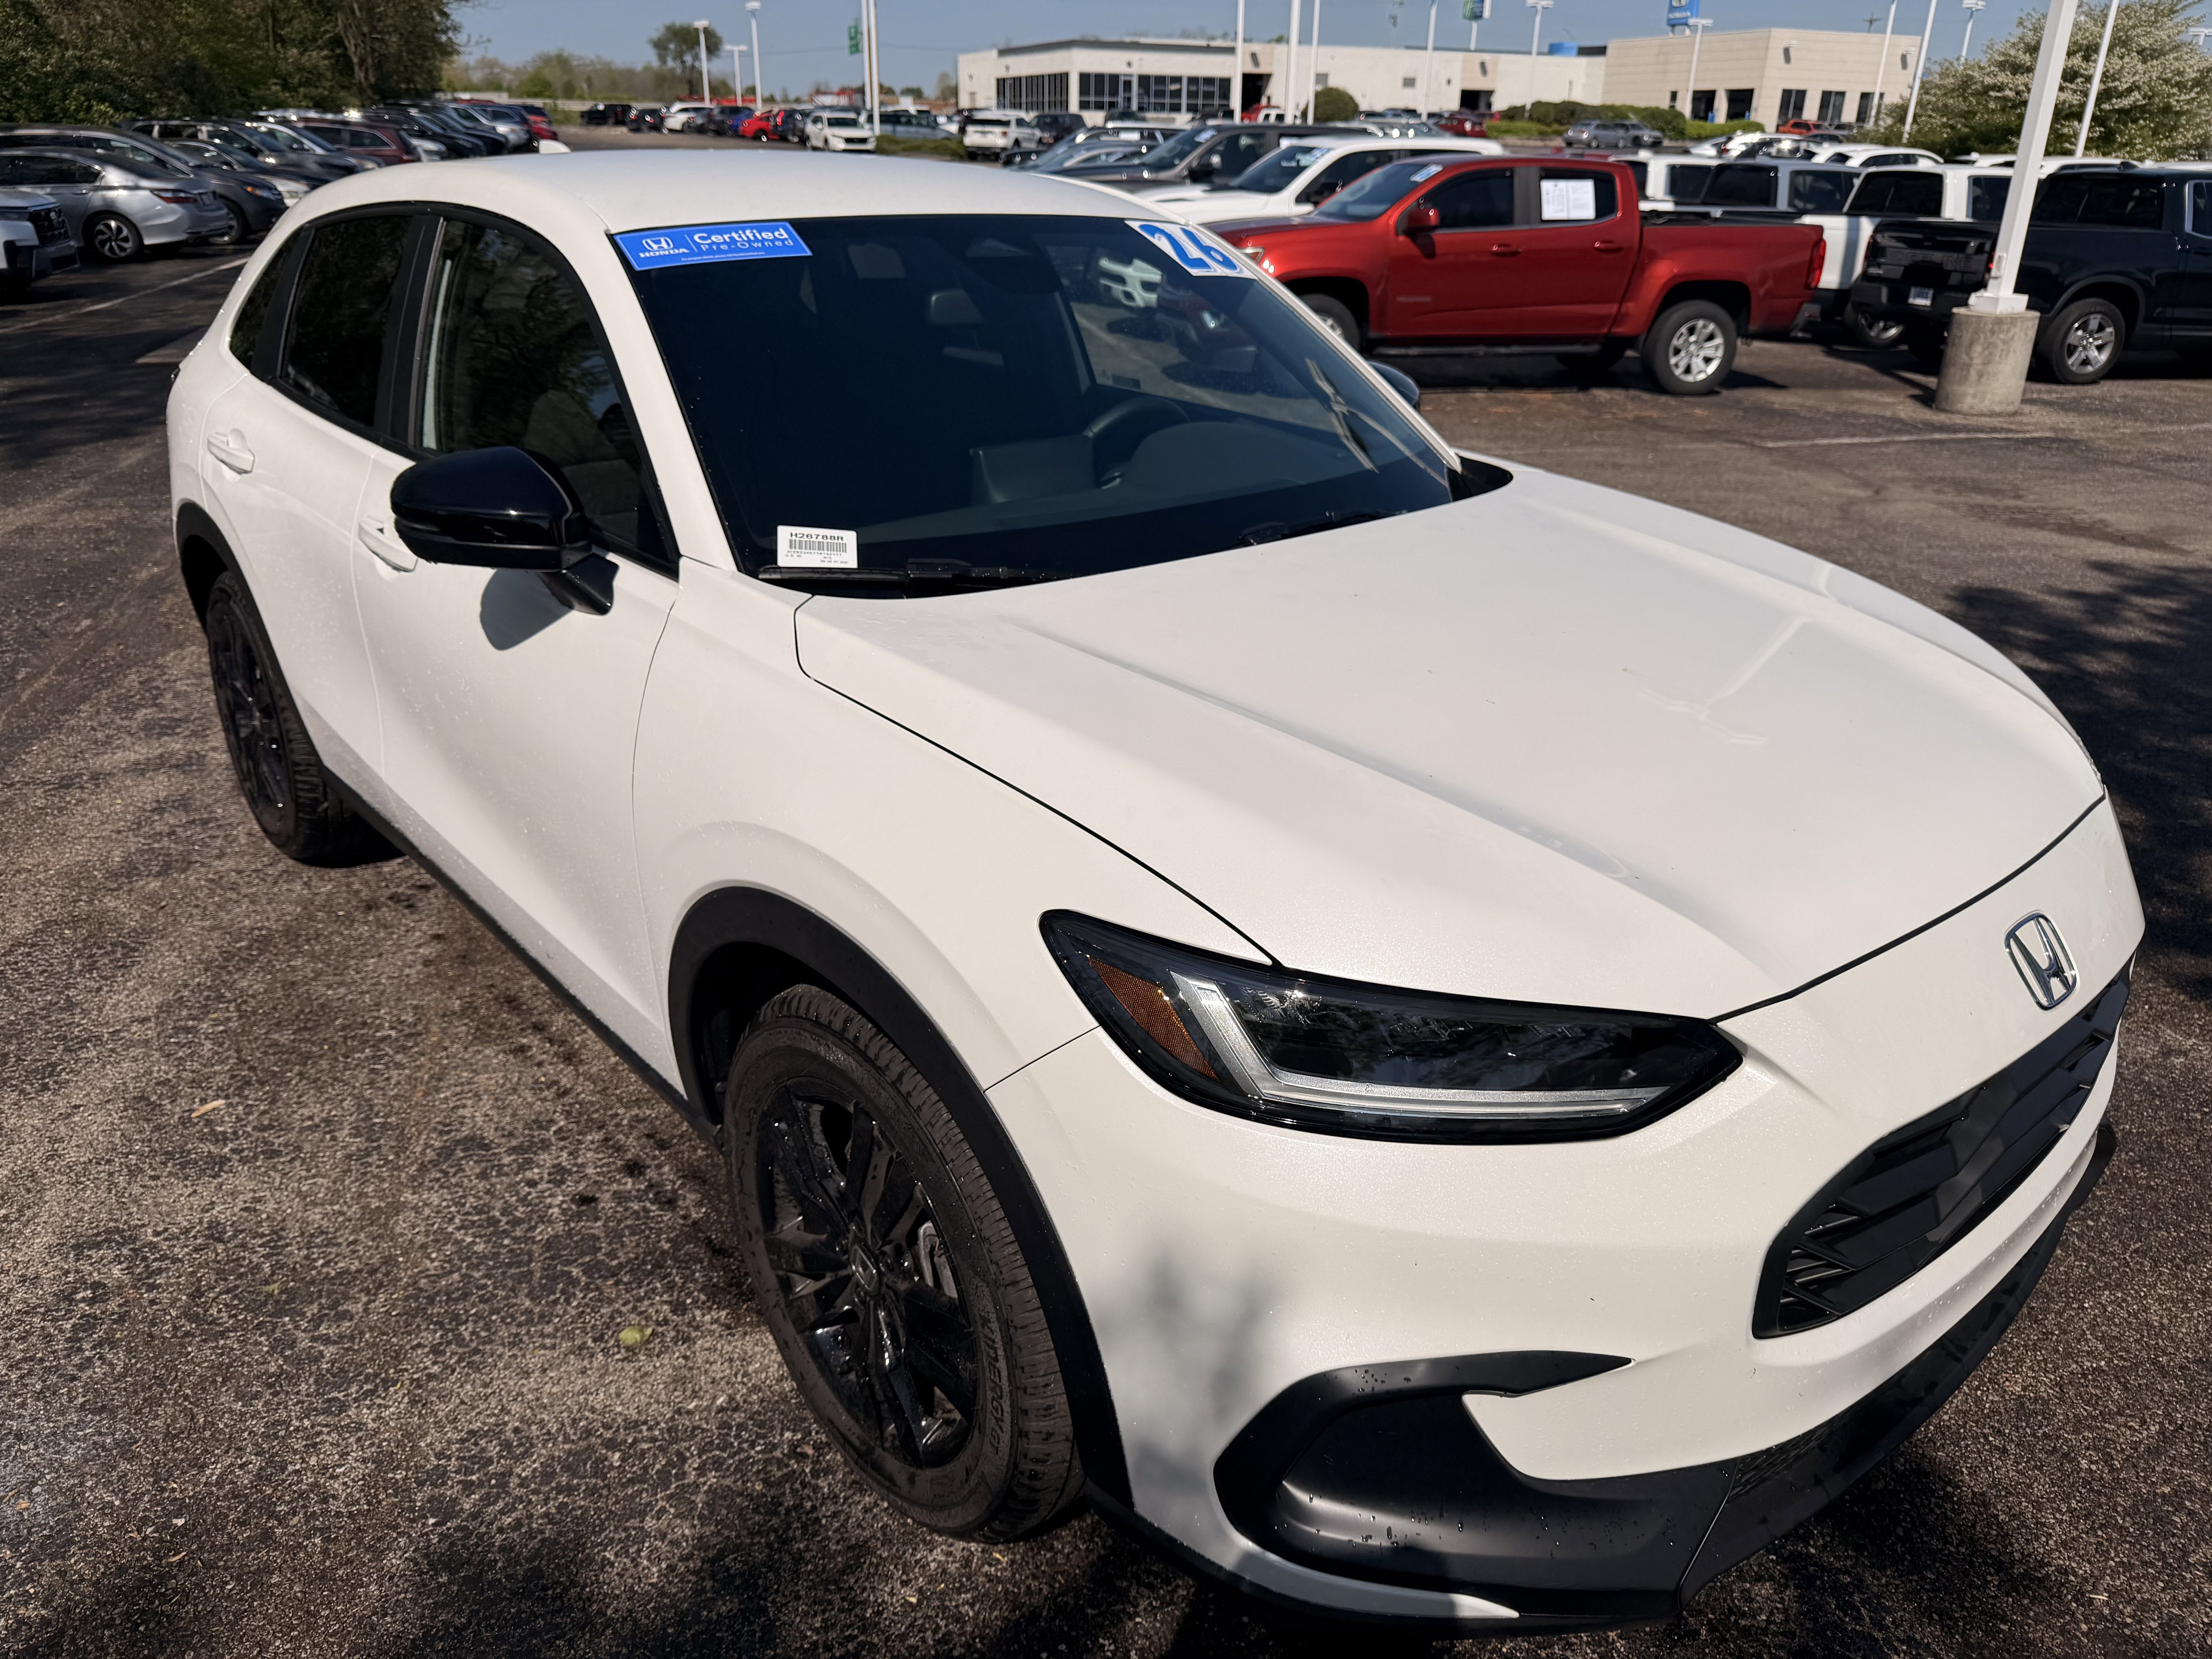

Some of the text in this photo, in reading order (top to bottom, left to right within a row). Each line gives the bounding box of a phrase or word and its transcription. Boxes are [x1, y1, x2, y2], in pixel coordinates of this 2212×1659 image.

[693, 227, 789, 244] Certified
[700, 239, 793, 251] Pre-Owned
[638, 247, 690, 258] HONDA
[790, 532, 844, 542] H26788R
[978, 1313, 1004, 1456] KINERGY GT
